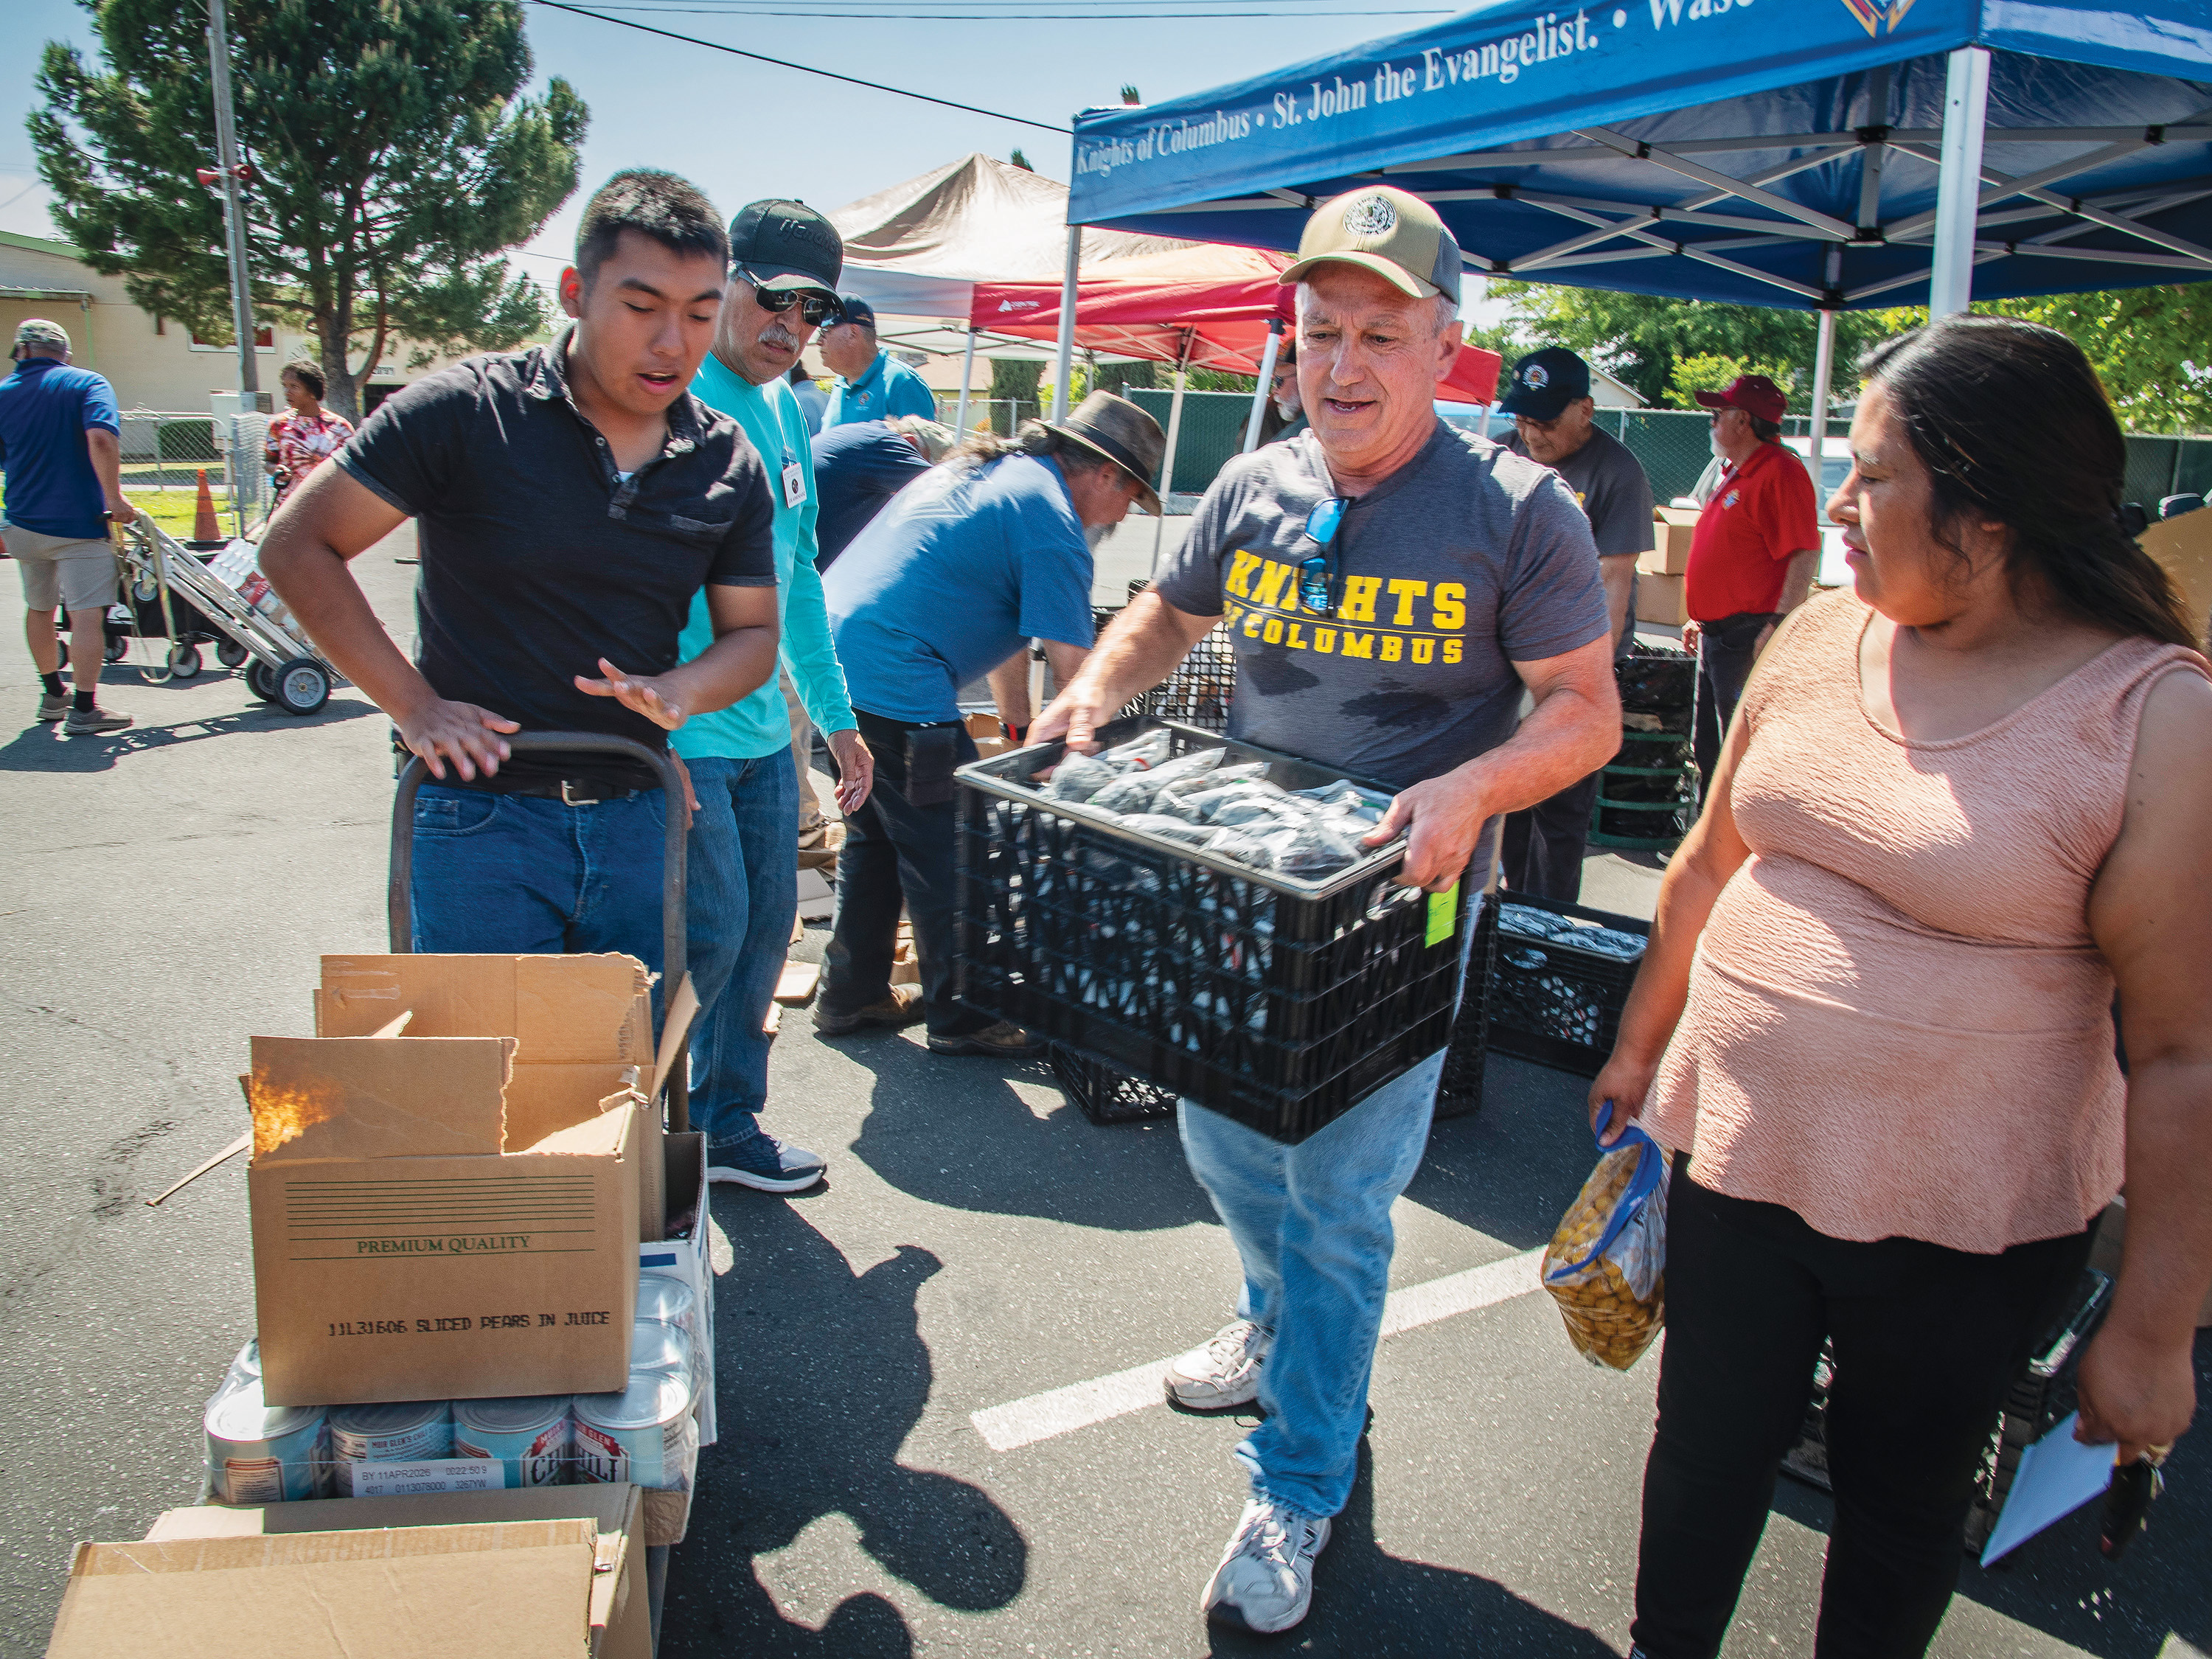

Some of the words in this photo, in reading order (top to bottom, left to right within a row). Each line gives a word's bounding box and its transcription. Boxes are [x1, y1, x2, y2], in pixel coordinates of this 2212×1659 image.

[1076, 138, 1135, 178] Knights
[1136, 127, 1157, 161] of
[1158, 110, 1251, 157] Columbus
[1272, 91, 1302, 130] St.
[1307, 76, 1367, 121] John
[1374, 62, 1416, 104] the
[1420, 7, 1599, 92] Evangelist.
[1225, 549, 1466, 630] KNIHTS
[1243, 613, 1464, 664] COLUMBUS
[357, 1239, 444, 1253] PREMIUM
[448, 1236, 531, 1252] QUALITY
[416, 1318, 472, 1333] SLICED
[479, 1315, 530, 1330] PEARS
[538, 1314, 556, 1327] IN
[563, 1311, 611, 1326] JUICE
[588, 1429, 611, 1447] GLEN
[362, 1472, 375, 1481] BY
